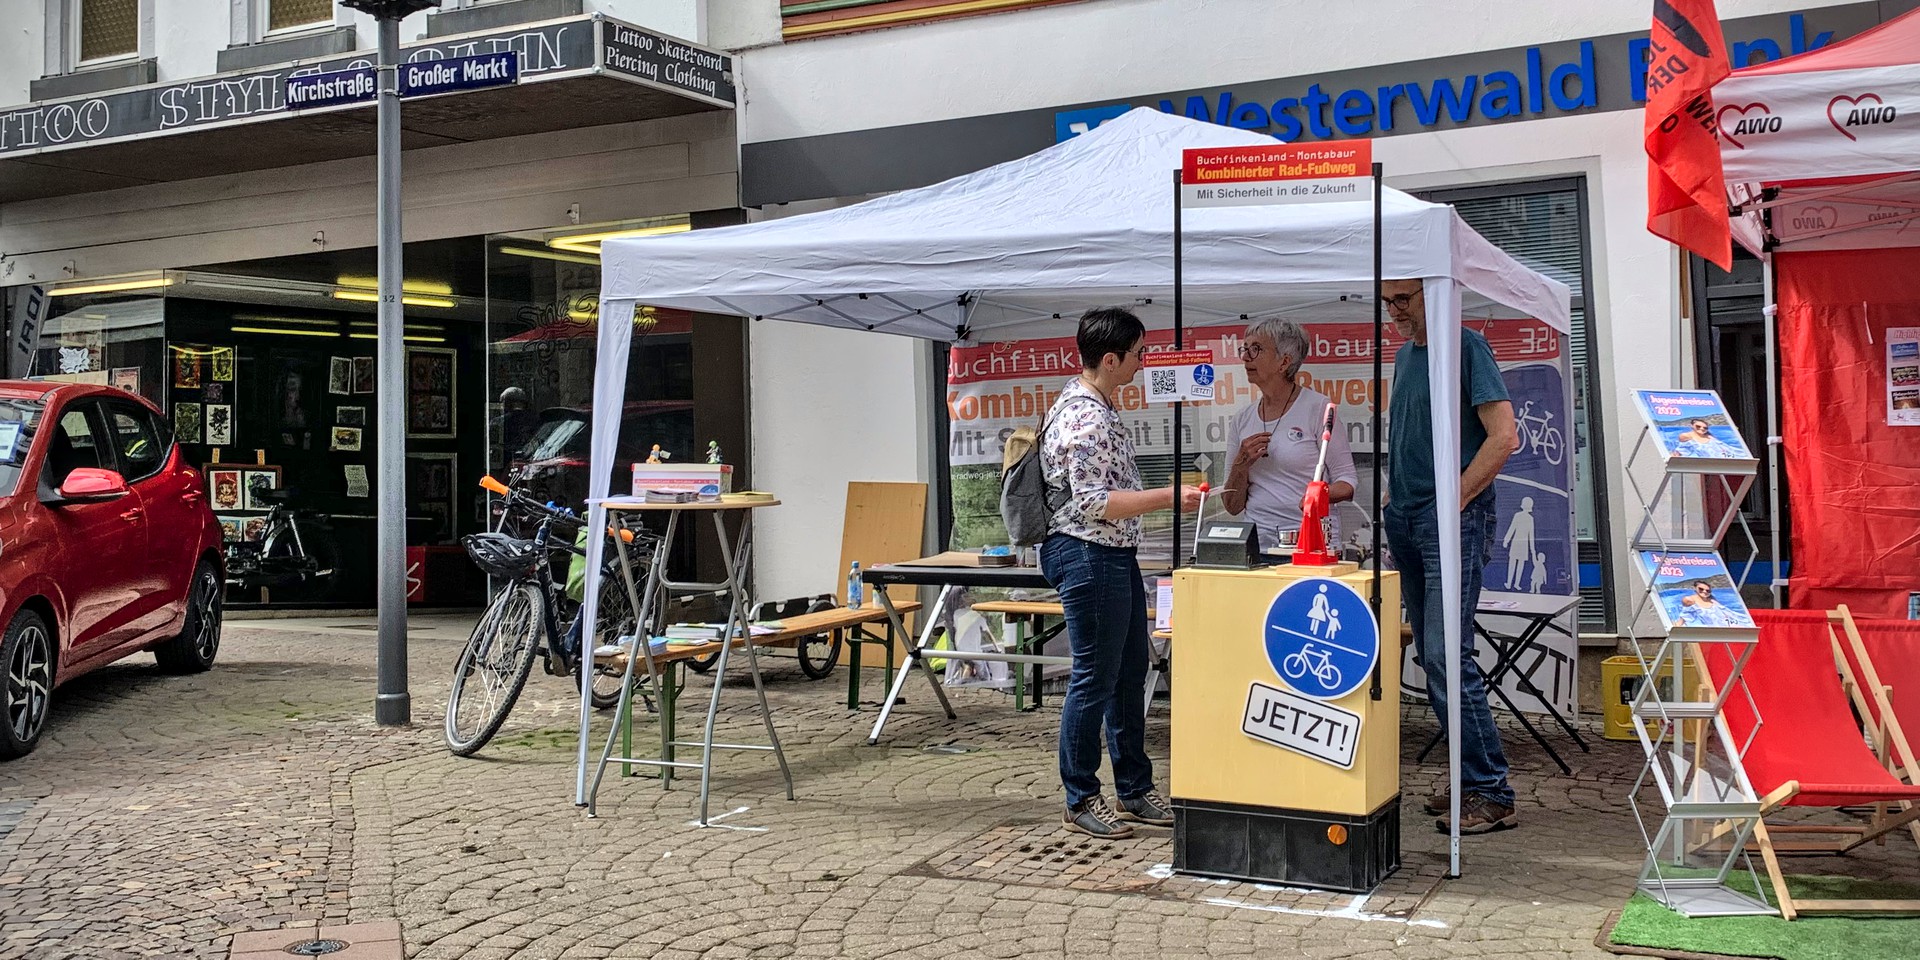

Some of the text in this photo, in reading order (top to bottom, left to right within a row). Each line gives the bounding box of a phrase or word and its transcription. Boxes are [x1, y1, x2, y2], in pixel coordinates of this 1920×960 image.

[612, 23, 723, 72] Tattoo Skateboard
[408, 57, 508, 87] Großer Markt
[606, 45, 658, 82] Piercing
[665, 62, 716, 98] Clothing
[1158, 14, 1836, 143] Westerwald Bnk
[160, 64, 322, 130] STYL
[288, 73, 374, 103] Kirchstraße
[1734, 116, 1782, 136] AWO
[1846, 106, 1897, 127] AWO
[1197, 152, 1287, 165] Buchfinkenland
[1297, 149, 1357, 160] Montabaur
[1197, 162, 1356, 180] Kombinierter Rad-Fußweg
[1197, 183, 1356, 199] Mit Sicherheit in die Zukunft
[1221, 333, 1390, 358] Mbaur
[1649, 394, 1715, 406] Jugendreisen
[1654, 406, 1682, 416] 2023
[1251, 698, 1349, 752] JETZT!
